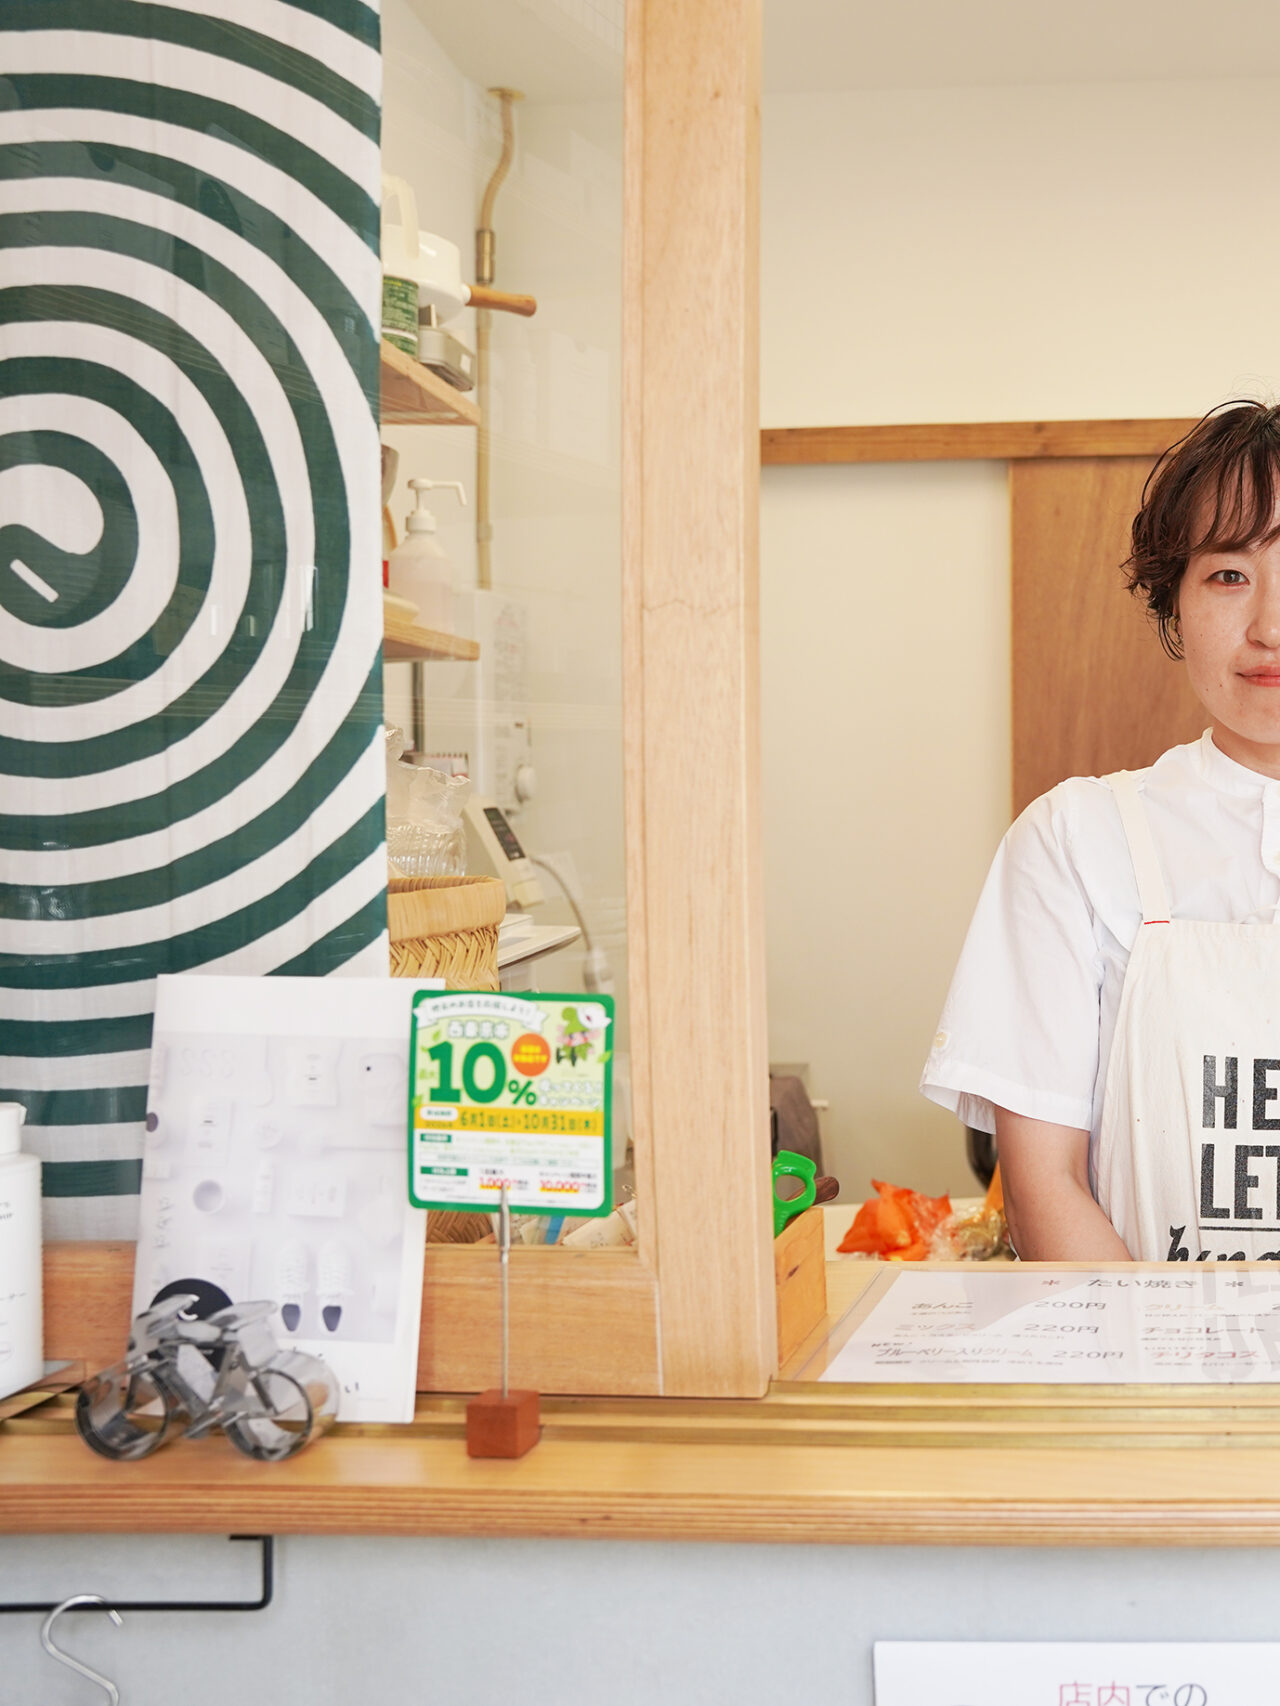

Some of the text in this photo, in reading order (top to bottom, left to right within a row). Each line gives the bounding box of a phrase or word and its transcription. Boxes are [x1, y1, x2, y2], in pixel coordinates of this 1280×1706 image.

[428, 1041, 537, 1105] 10%
[1087, 1278, 1196, 1289] たい焼き
[911, 1301, 1107, 1310] あんこ 200円
[1024, 1322, 1100, 1333] 220円
[1142, 1326, 1265, 1335] チョコレート
[1053, 1350, 1124, 1359] 220円
[1059, 1680, 1208, 1706] 店内での
